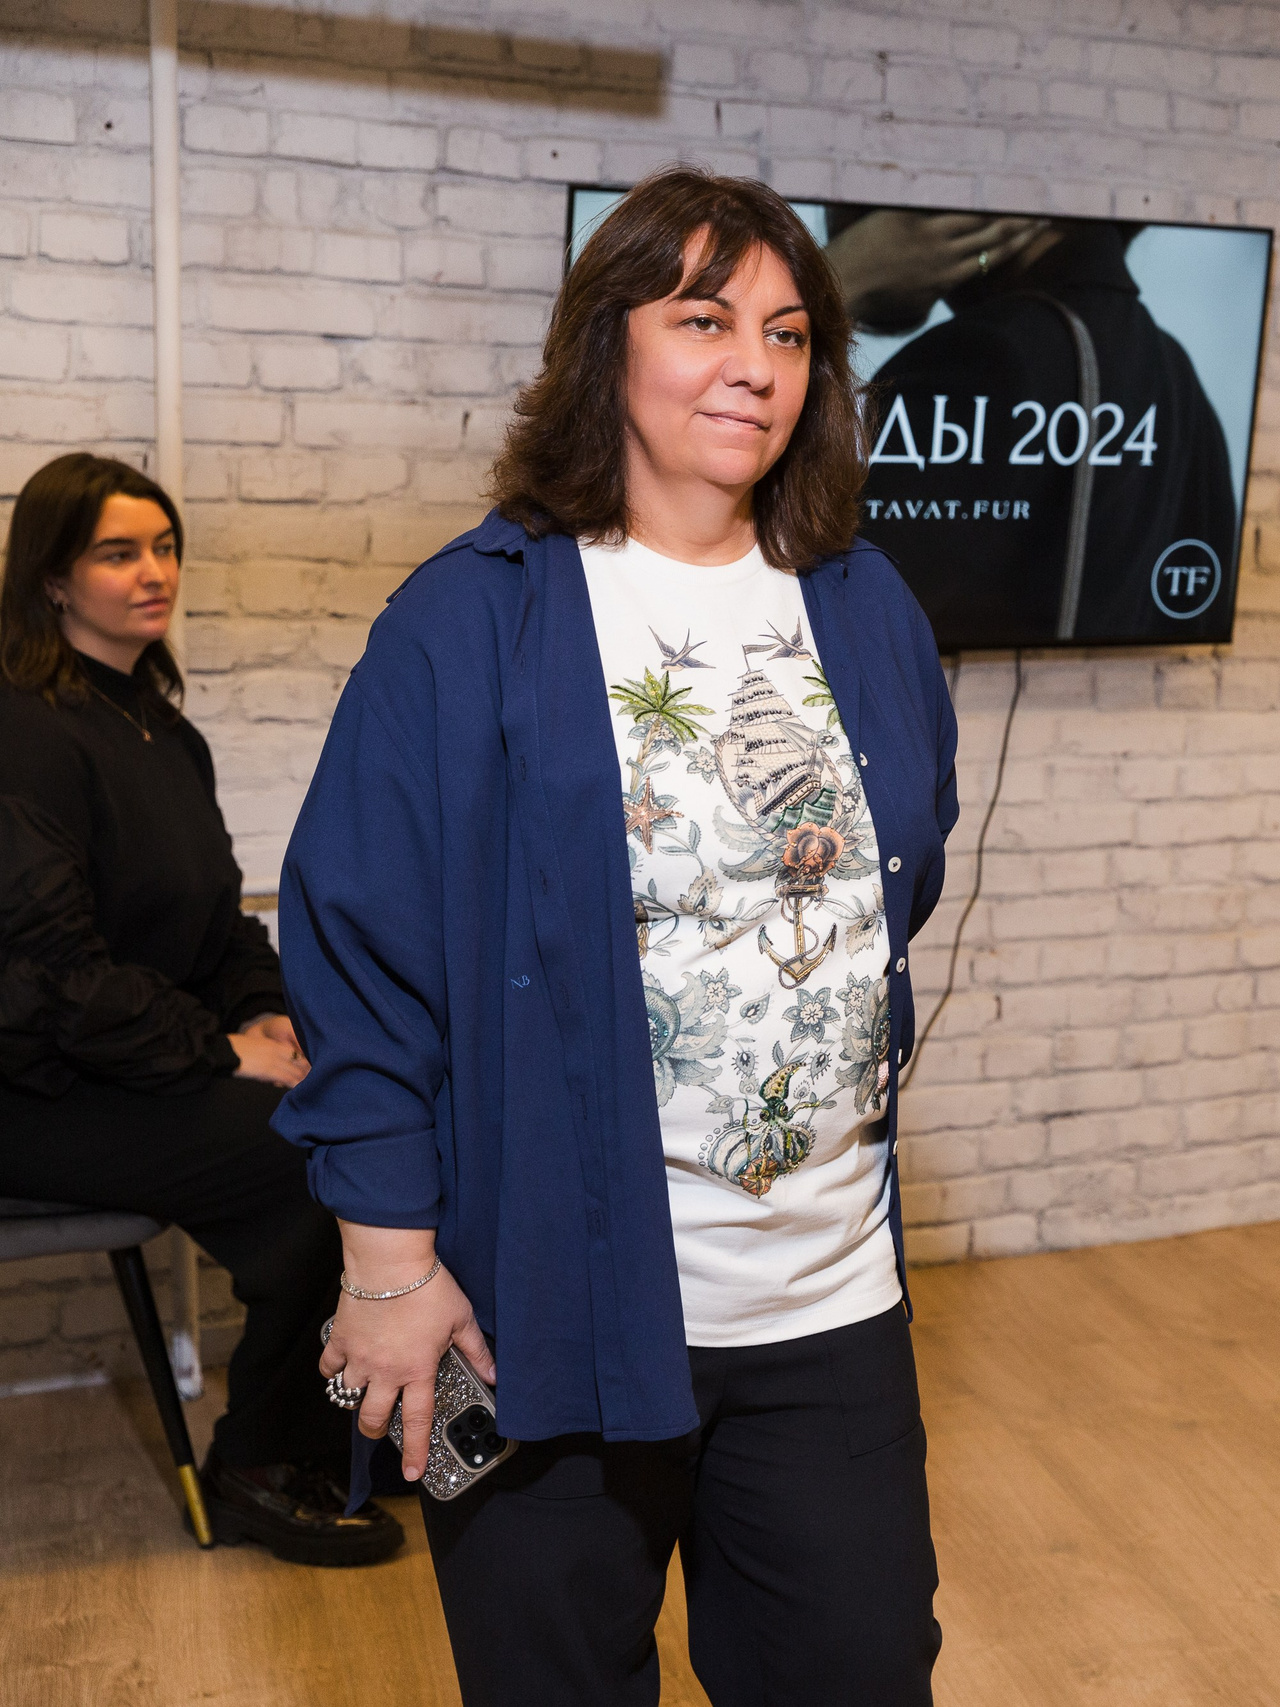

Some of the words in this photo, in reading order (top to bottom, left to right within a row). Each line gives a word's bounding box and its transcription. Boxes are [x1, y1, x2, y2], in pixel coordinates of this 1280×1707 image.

[1009, 400, 1158, 466] 2024
[866, 499, 1030, 520] TAVAT.FUR
[1163, 566, 1211, 596] TF
